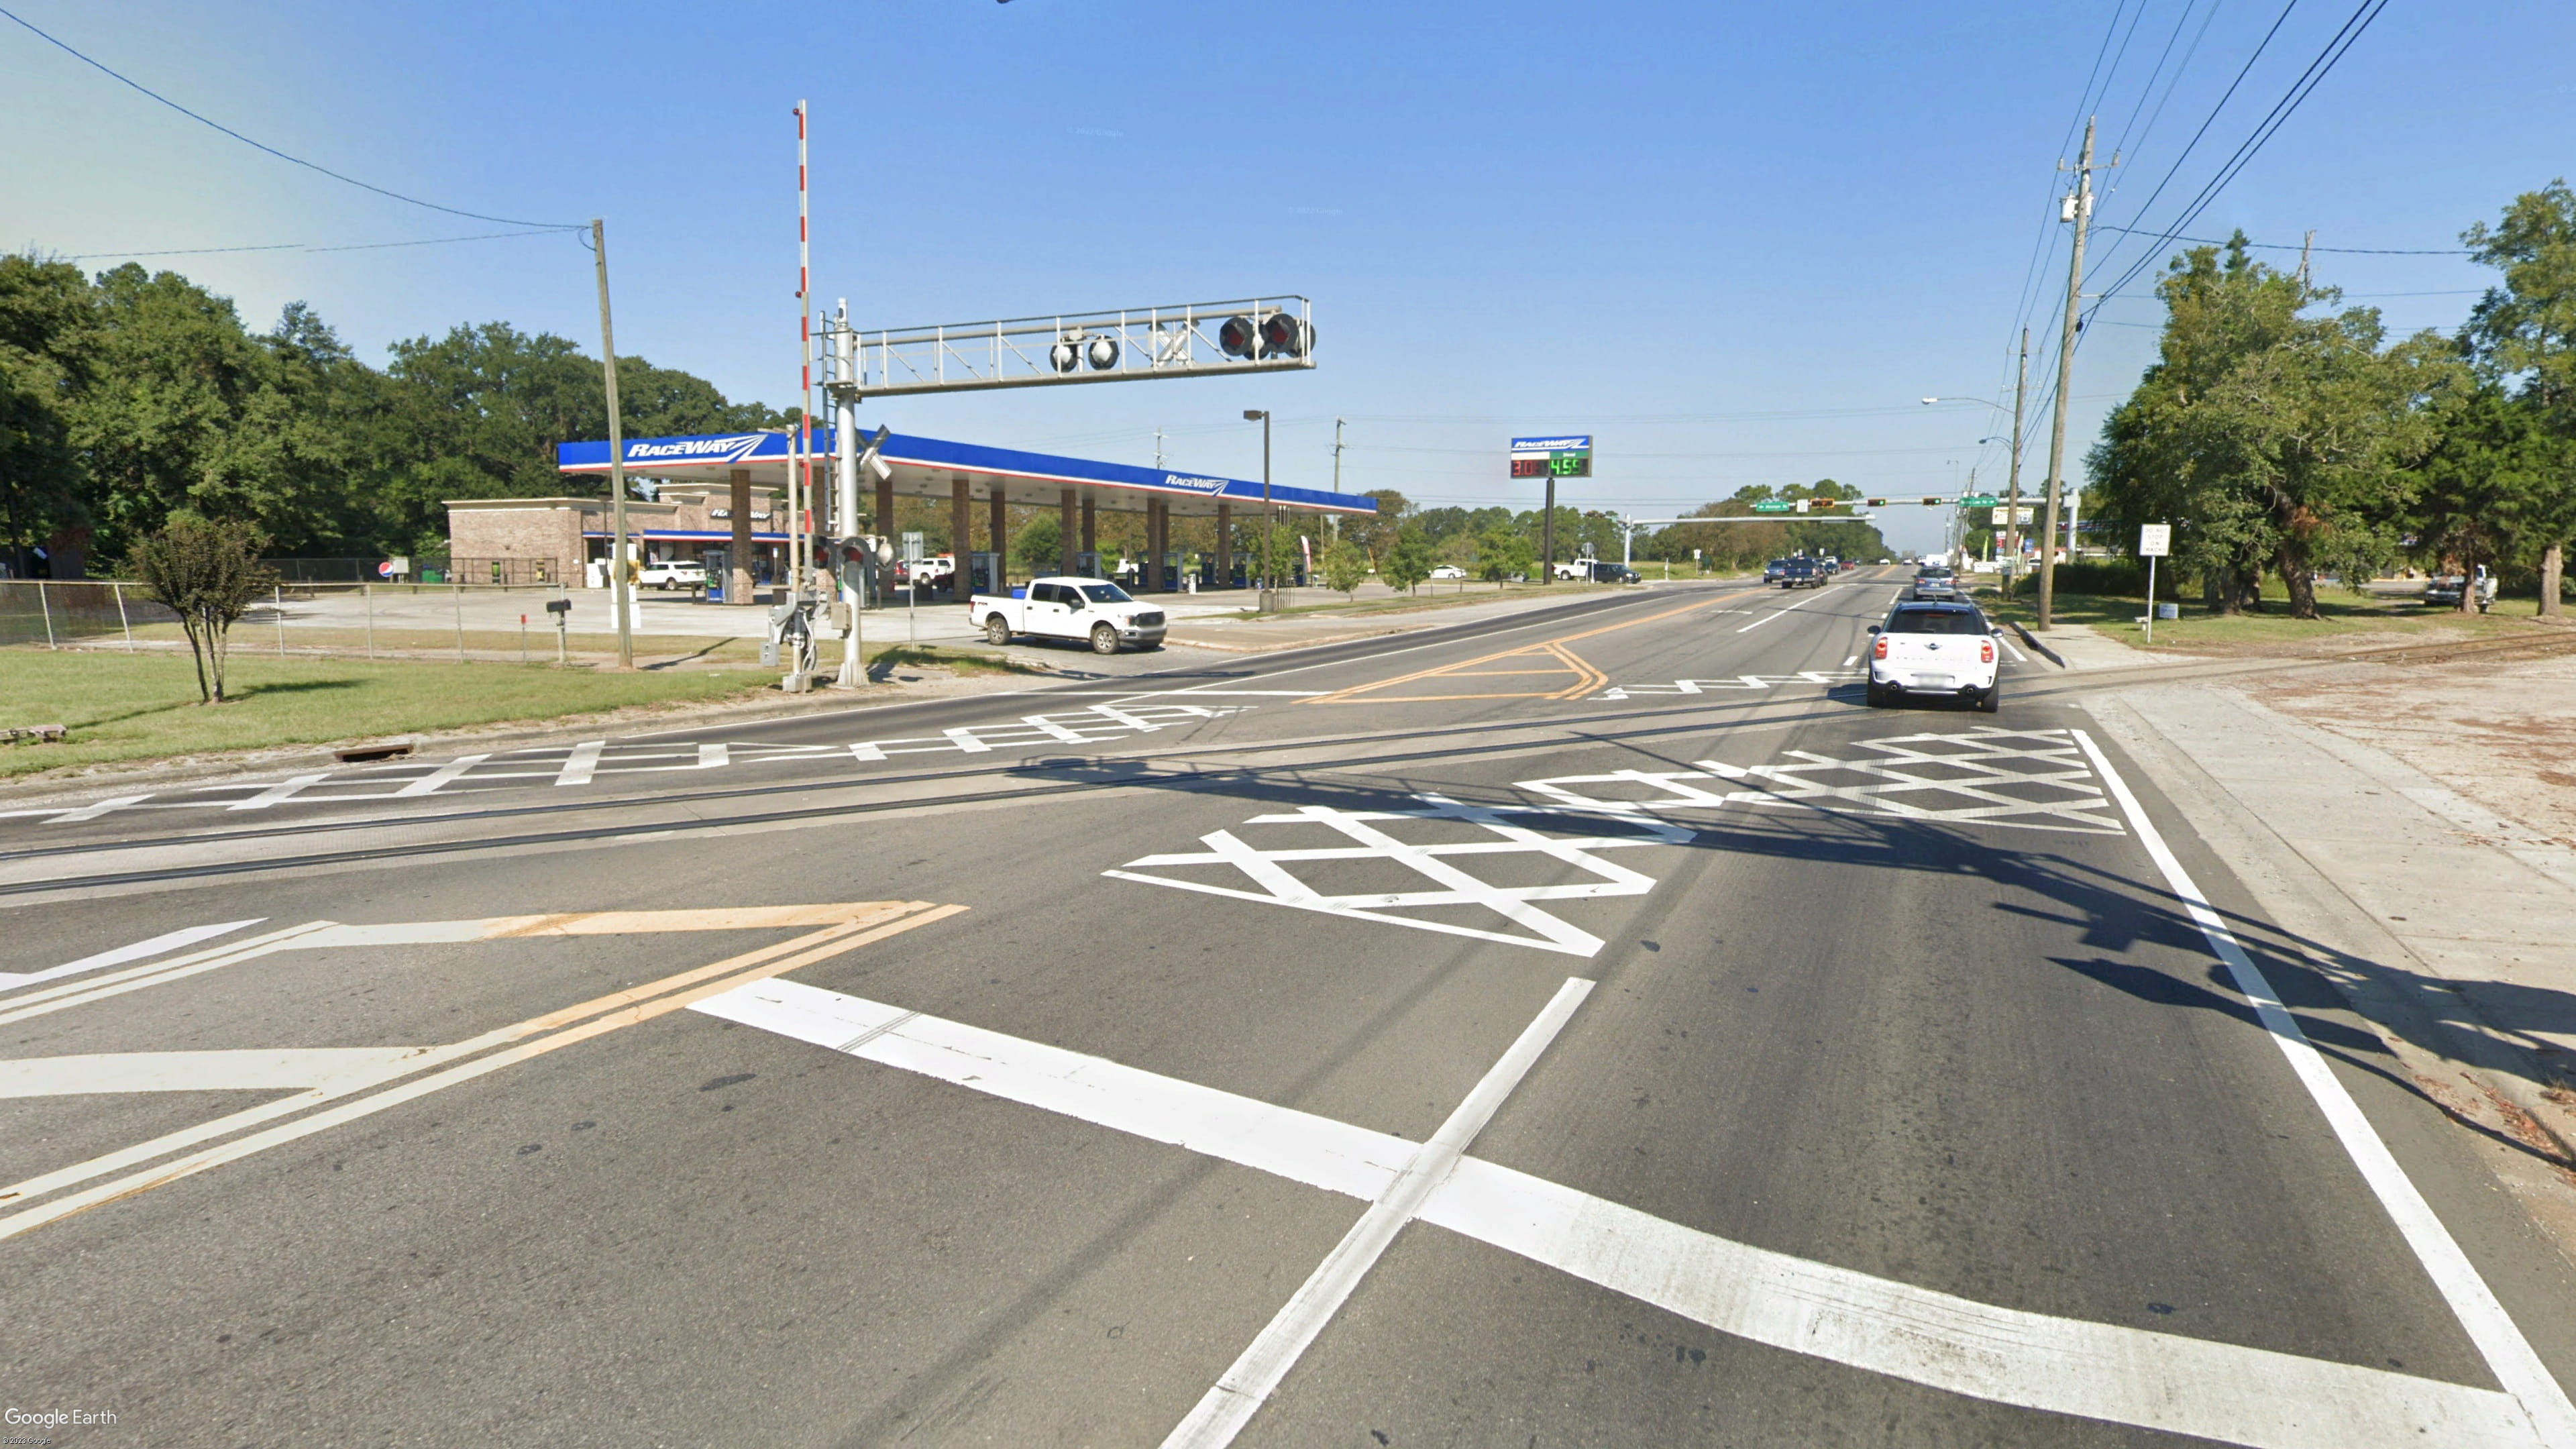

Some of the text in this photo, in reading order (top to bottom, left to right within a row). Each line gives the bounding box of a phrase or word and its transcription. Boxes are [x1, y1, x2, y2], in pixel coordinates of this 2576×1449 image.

[628, 440, 737, 458] RACEWAY
[1514, 439, 1570, 448] RACEWAY
[1166, 474, 1216, 489] RACEWAY
[711, 509, 770, 519] RAAY
